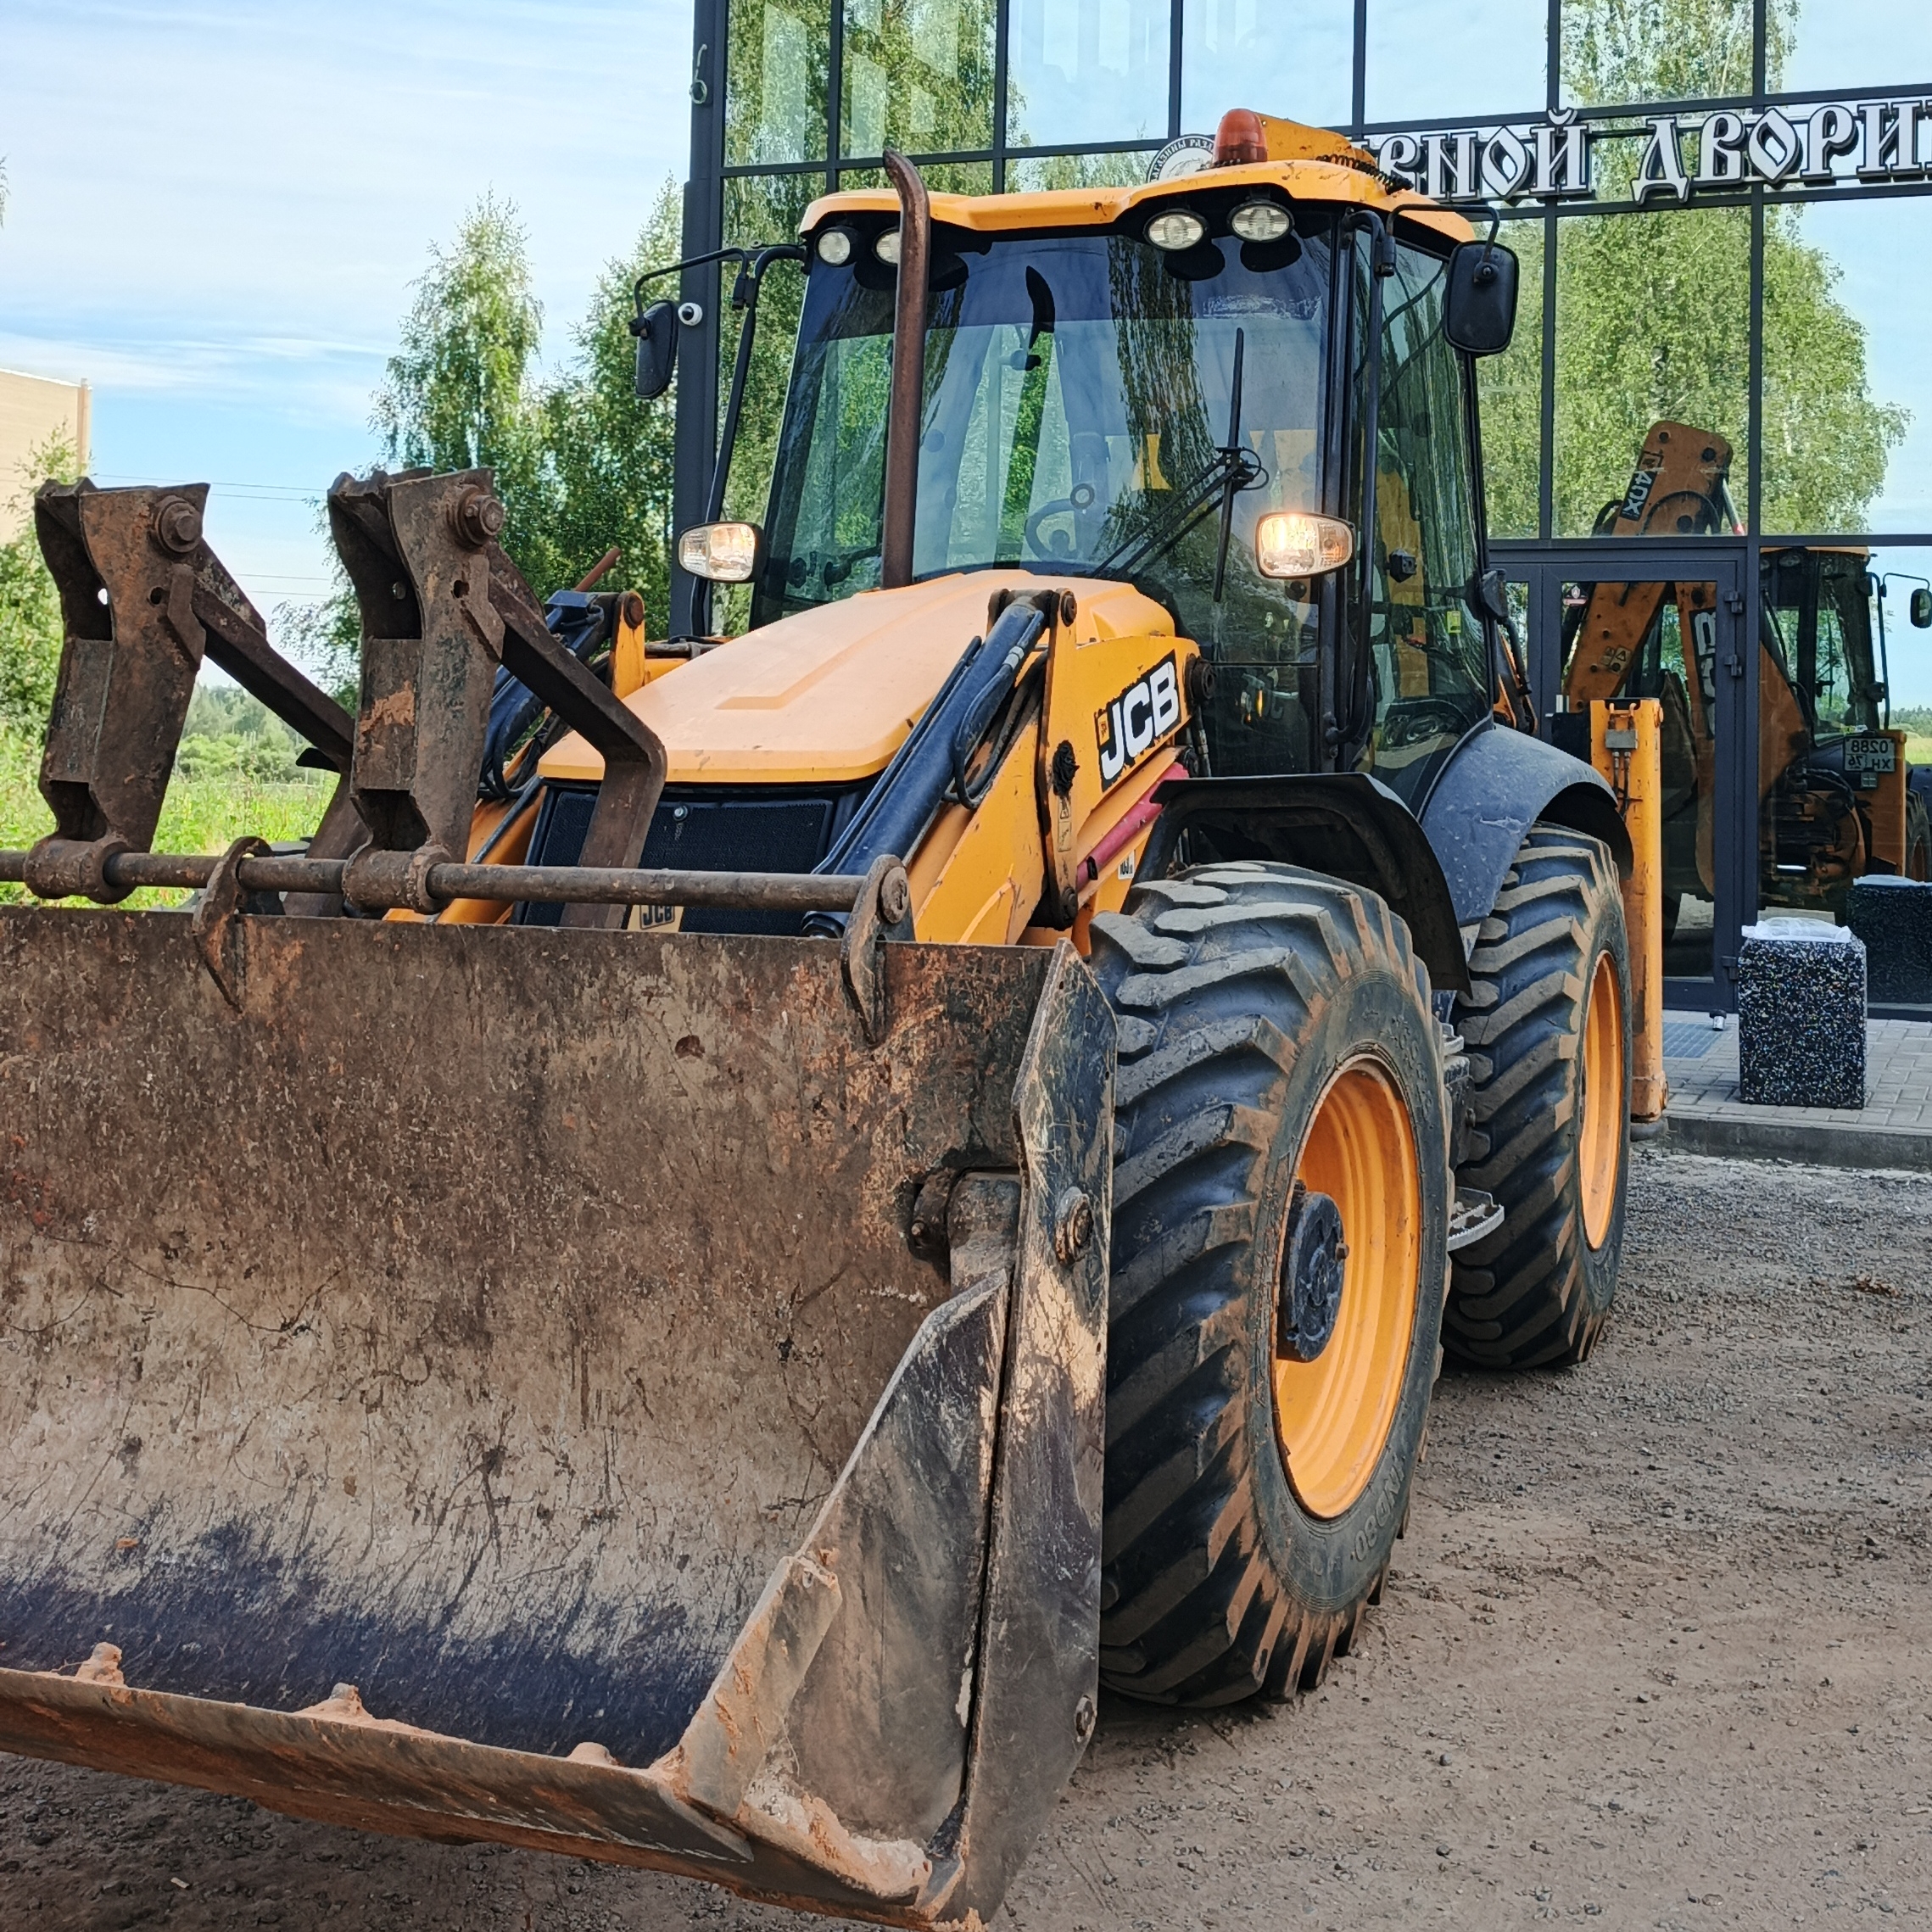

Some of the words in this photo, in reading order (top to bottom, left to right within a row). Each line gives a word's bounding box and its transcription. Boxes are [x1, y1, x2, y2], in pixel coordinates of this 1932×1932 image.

[1352, 107, 1592, 201] ВНОЙ
[1630, 100, 1932, 205] ДВОРИ
[1101, 661, 1180, 780] JCB
[642, 905, 673, 926] JCB
